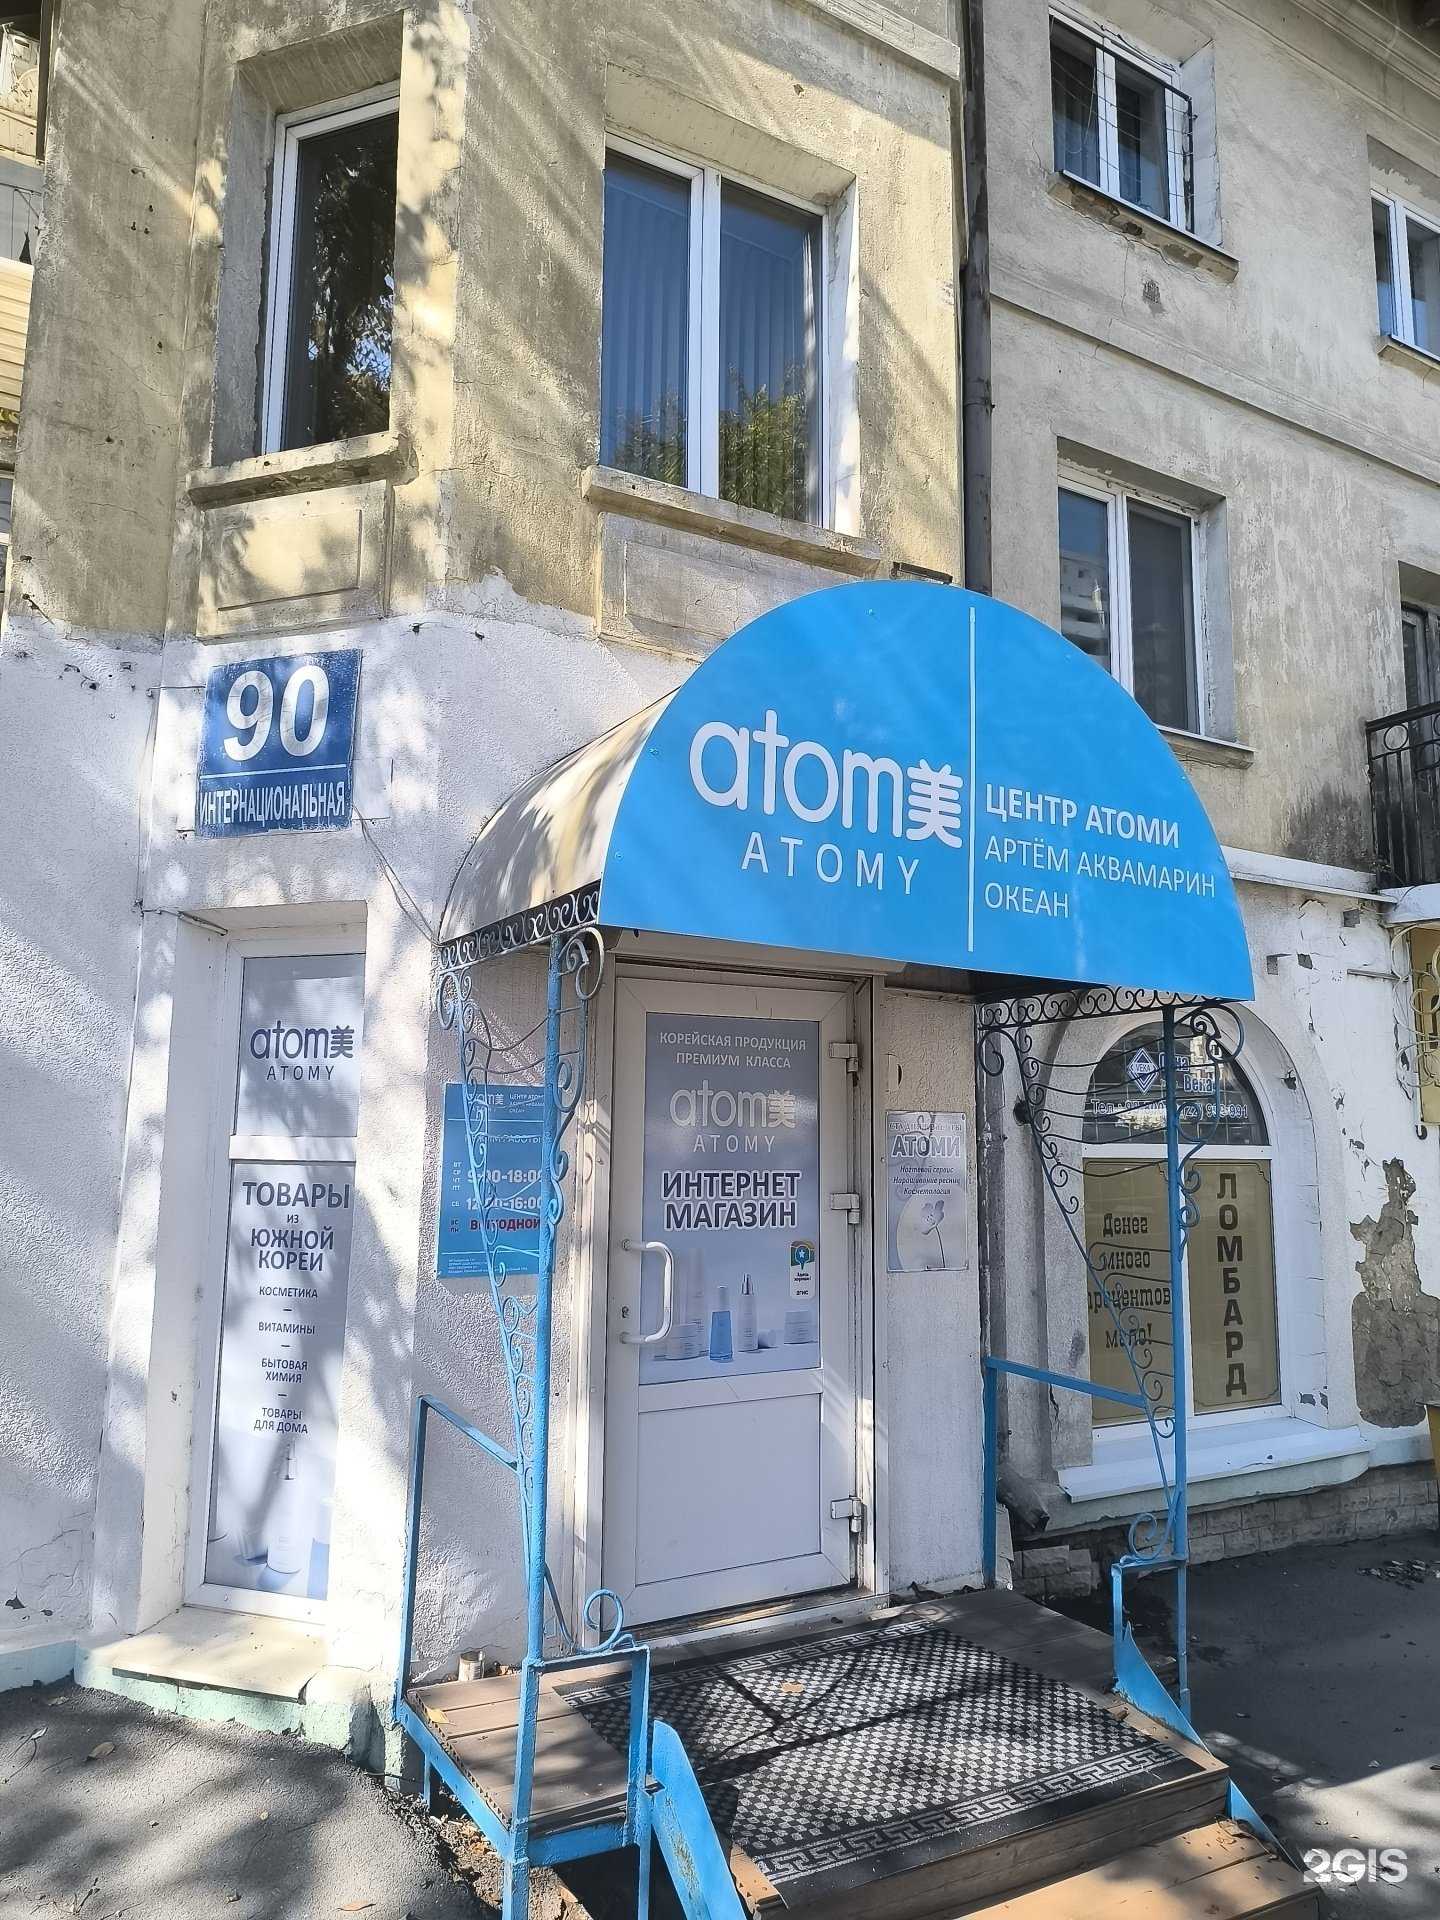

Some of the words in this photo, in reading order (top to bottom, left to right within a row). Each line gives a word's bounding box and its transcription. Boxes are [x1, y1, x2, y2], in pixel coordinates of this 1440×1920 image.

[224, 665, 330, 761] 90
[689, 709, 964, 849] atom美
[200, 781, 345, 827] ИНТЕРНАЦИОНАЛЬНАЯ
[986, 783, 1077, 827] ЦЕНТР
[1085, 804, 1179, 849] АТОМИ
[741, 831, 920, 895] ATOMY
[984, 835, 1069, 873] АРТЁМ
[1077, 851, 1215, 898] АКВАМАРИН
[984, 882, 1069, 918] ОКЕАН
[660, 1031, 731, 1047] КОРЕЙСКАЯ
[735, 1035, 806, 1051] ПРОДУКЦИЯ
[676, 1052, 740, 1066] ПРЕМИУМ
[746, 1055, 791, 1068] КЛАССА
[267, 1065, 335, 1081] ATOMY
[693, 1134, 775, 1153] ATOMY
[892, 1135, 960, 1158] АТОМИ
[242, 1181, 350, 1209] ТОВАРЫ
[662, 1171, 802, 1199] ИНТЕРНЕТ
[665, 1201, 798, 1230] МАГАЗИН
[1103, 1213, 1148, 1238] Денег
[251, 1226, 334, 1251] ЮЖНОЙ
[258, 1250, 323, 1271] КОРЕИ
[259, 1286, 318, 1298] КОСМЕТИКА
[1217, 1173, 1247, 1397] ЛОМБАРД
[258, 1321, 315, 1335] ВИТАМИНЫ
[261, 1358, 308, 1371] БЫТОВАЯ
[265, 1371, 302, 1384] ХИМИЯ
[262, 1407, 302, 1420] ТОВАРЫ
[253, 1420, 274, 1432] ДЛЯ
[277, 1421, 308, 1434] ДОМА
